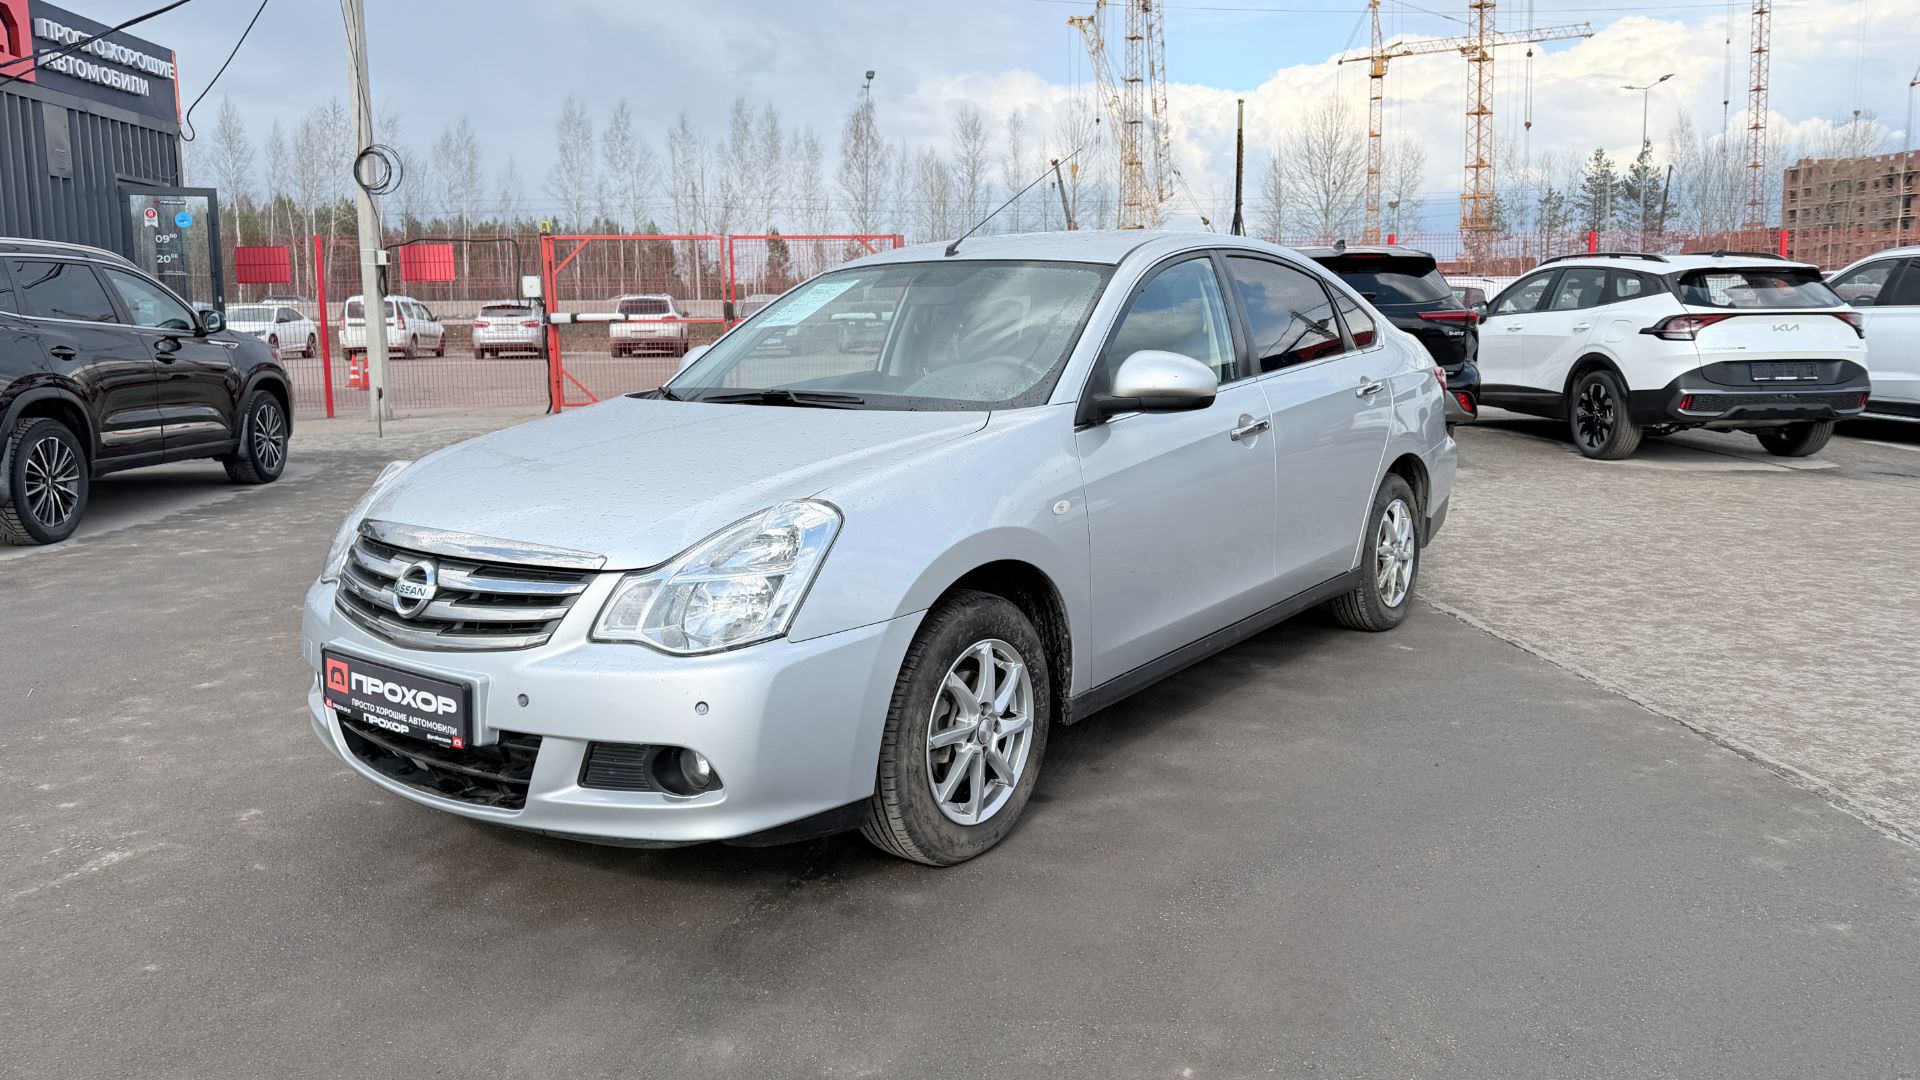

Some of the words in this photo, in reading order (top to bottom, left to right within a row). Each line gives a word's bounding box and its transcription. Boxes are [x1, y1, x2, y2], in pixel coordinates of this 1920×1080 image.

[34, 17, 105, 56] ПРОСТО
[102, 41, 175, 79] ХОРОШИЕ
[38, 49, 149, 97] АВТОМОБИЛИ
[351, 672, 457, 715] ПРОХОР
[351, 697, 375, 712] ПРОСТО
[375, 705, 408, 722] ХОРОШИЕ
[408, 715, 458, 736] АВТОМОБИЛИ
[363, 712, 410, 734] ПРОХОР
